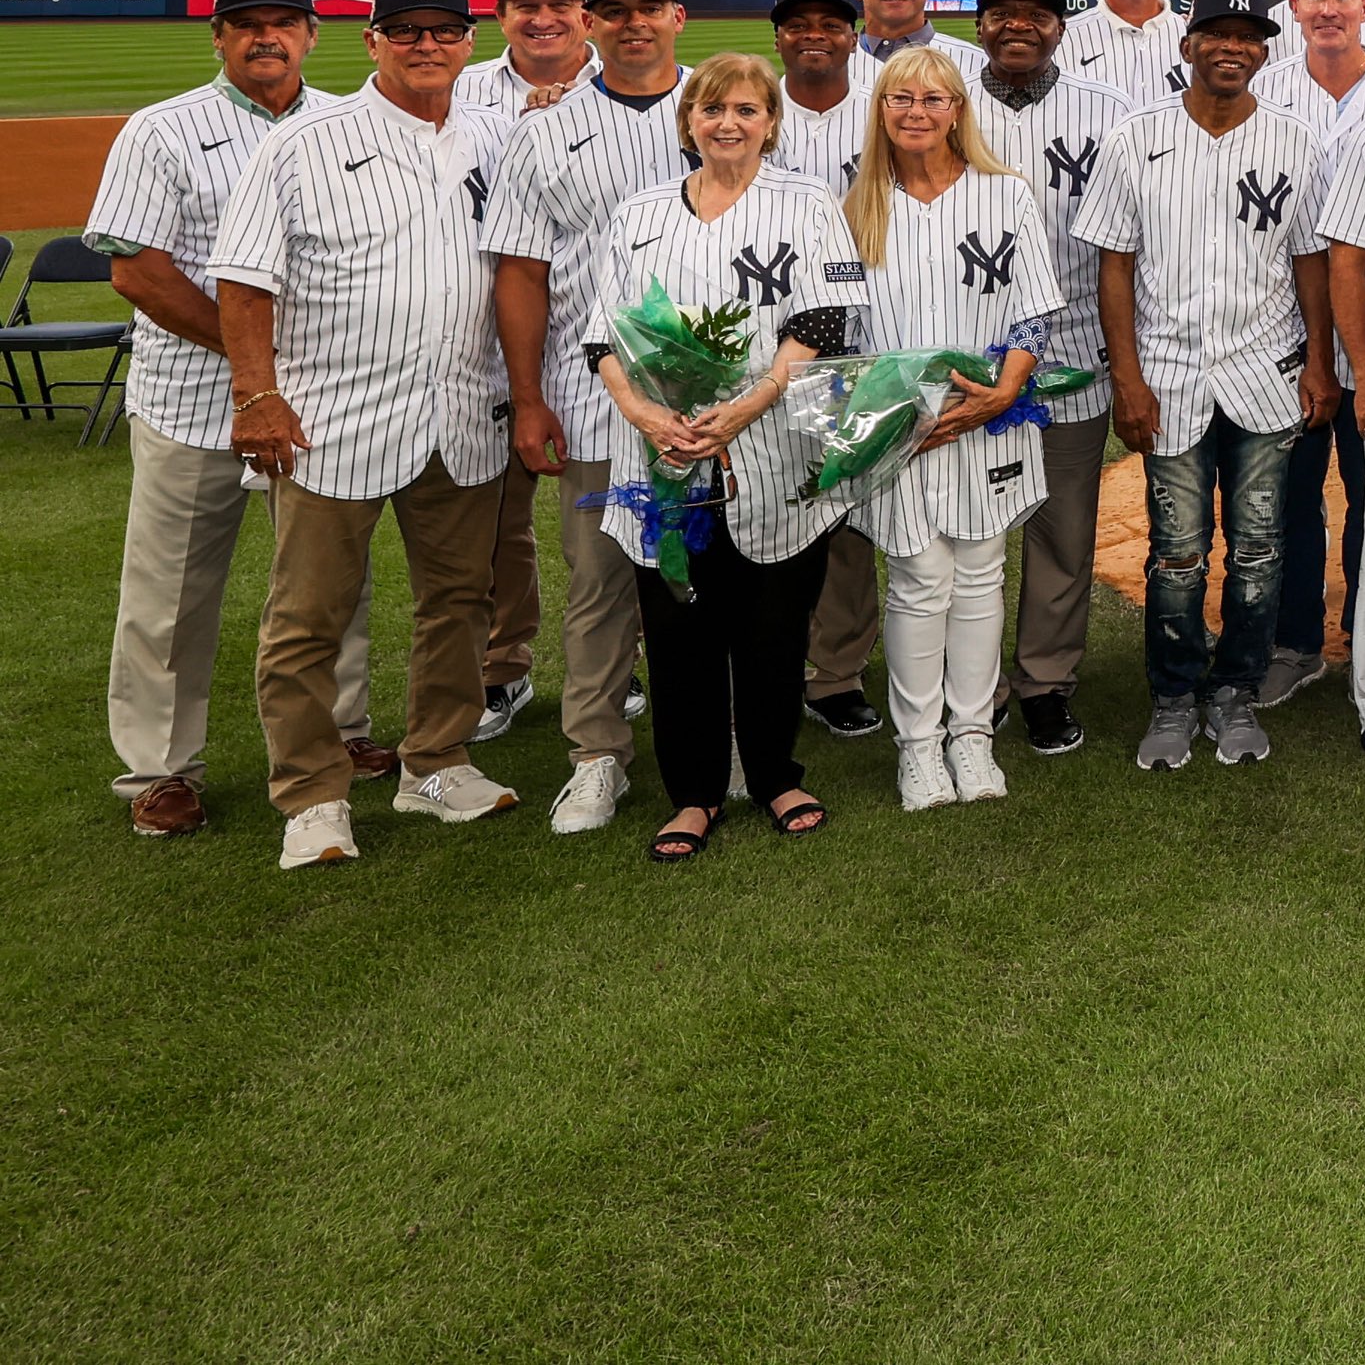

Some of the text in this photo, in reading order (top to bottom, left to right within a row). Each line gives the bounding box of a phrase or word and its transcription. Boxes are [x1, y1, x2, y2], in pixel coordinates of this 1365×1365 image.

[1236, 169, 1293, 232] NY
[731, 241, 799, 306] NY
[825, 263, 862, 274] STARR
[957, 230, 1015, 295] NY
